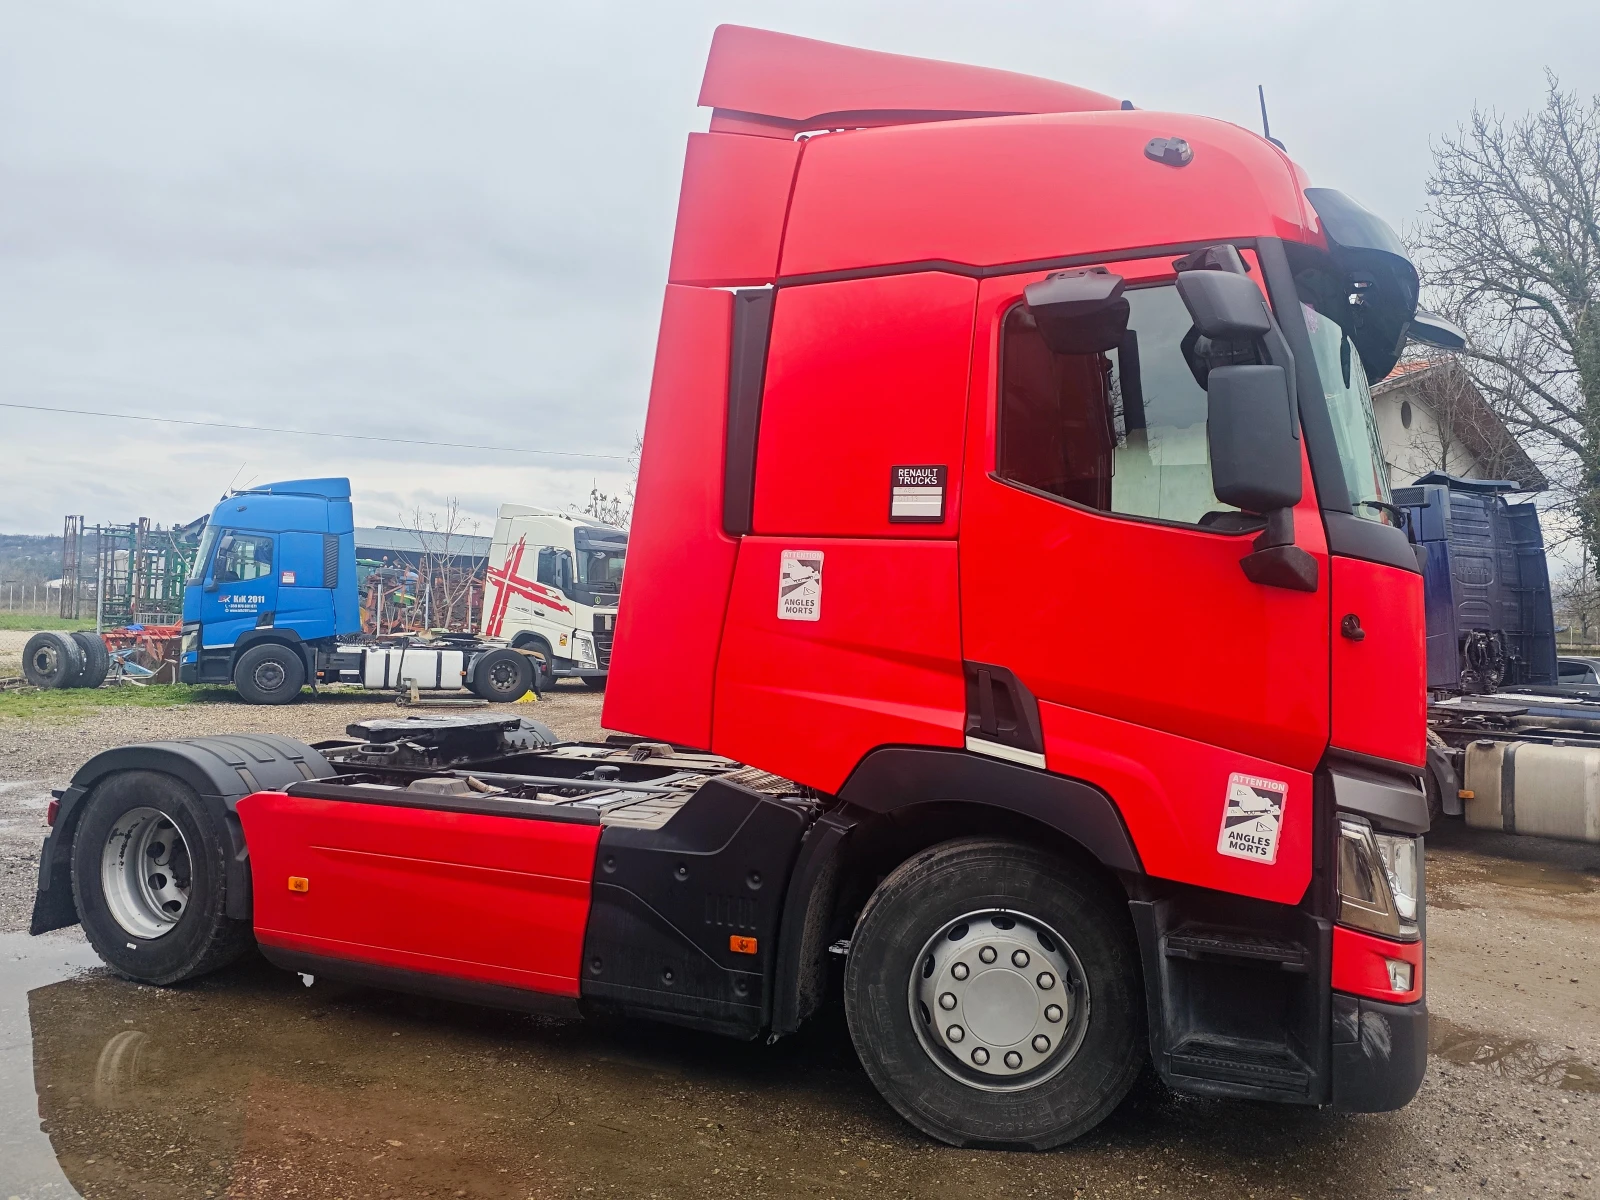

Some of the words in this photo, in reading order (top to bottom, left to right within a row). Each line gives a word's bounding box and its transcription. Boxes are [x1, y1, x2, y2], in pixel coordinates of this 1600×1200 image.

[898, 469, 938, 477] RENAULT
[898, 476, 938, 485] TRUCKS
[783, 551, 822, 559] ATTENTION
[247, 595, 265, 604] 2011
[784, 598, 815, 607] ANGLES
[785, 606, 813, 615] MORTS
[1232, 775, 1286, 792] ATTENTION
[1228, 831, 1271, 847] ANGLES
[1229, 841, 1268, 856] MORTS
